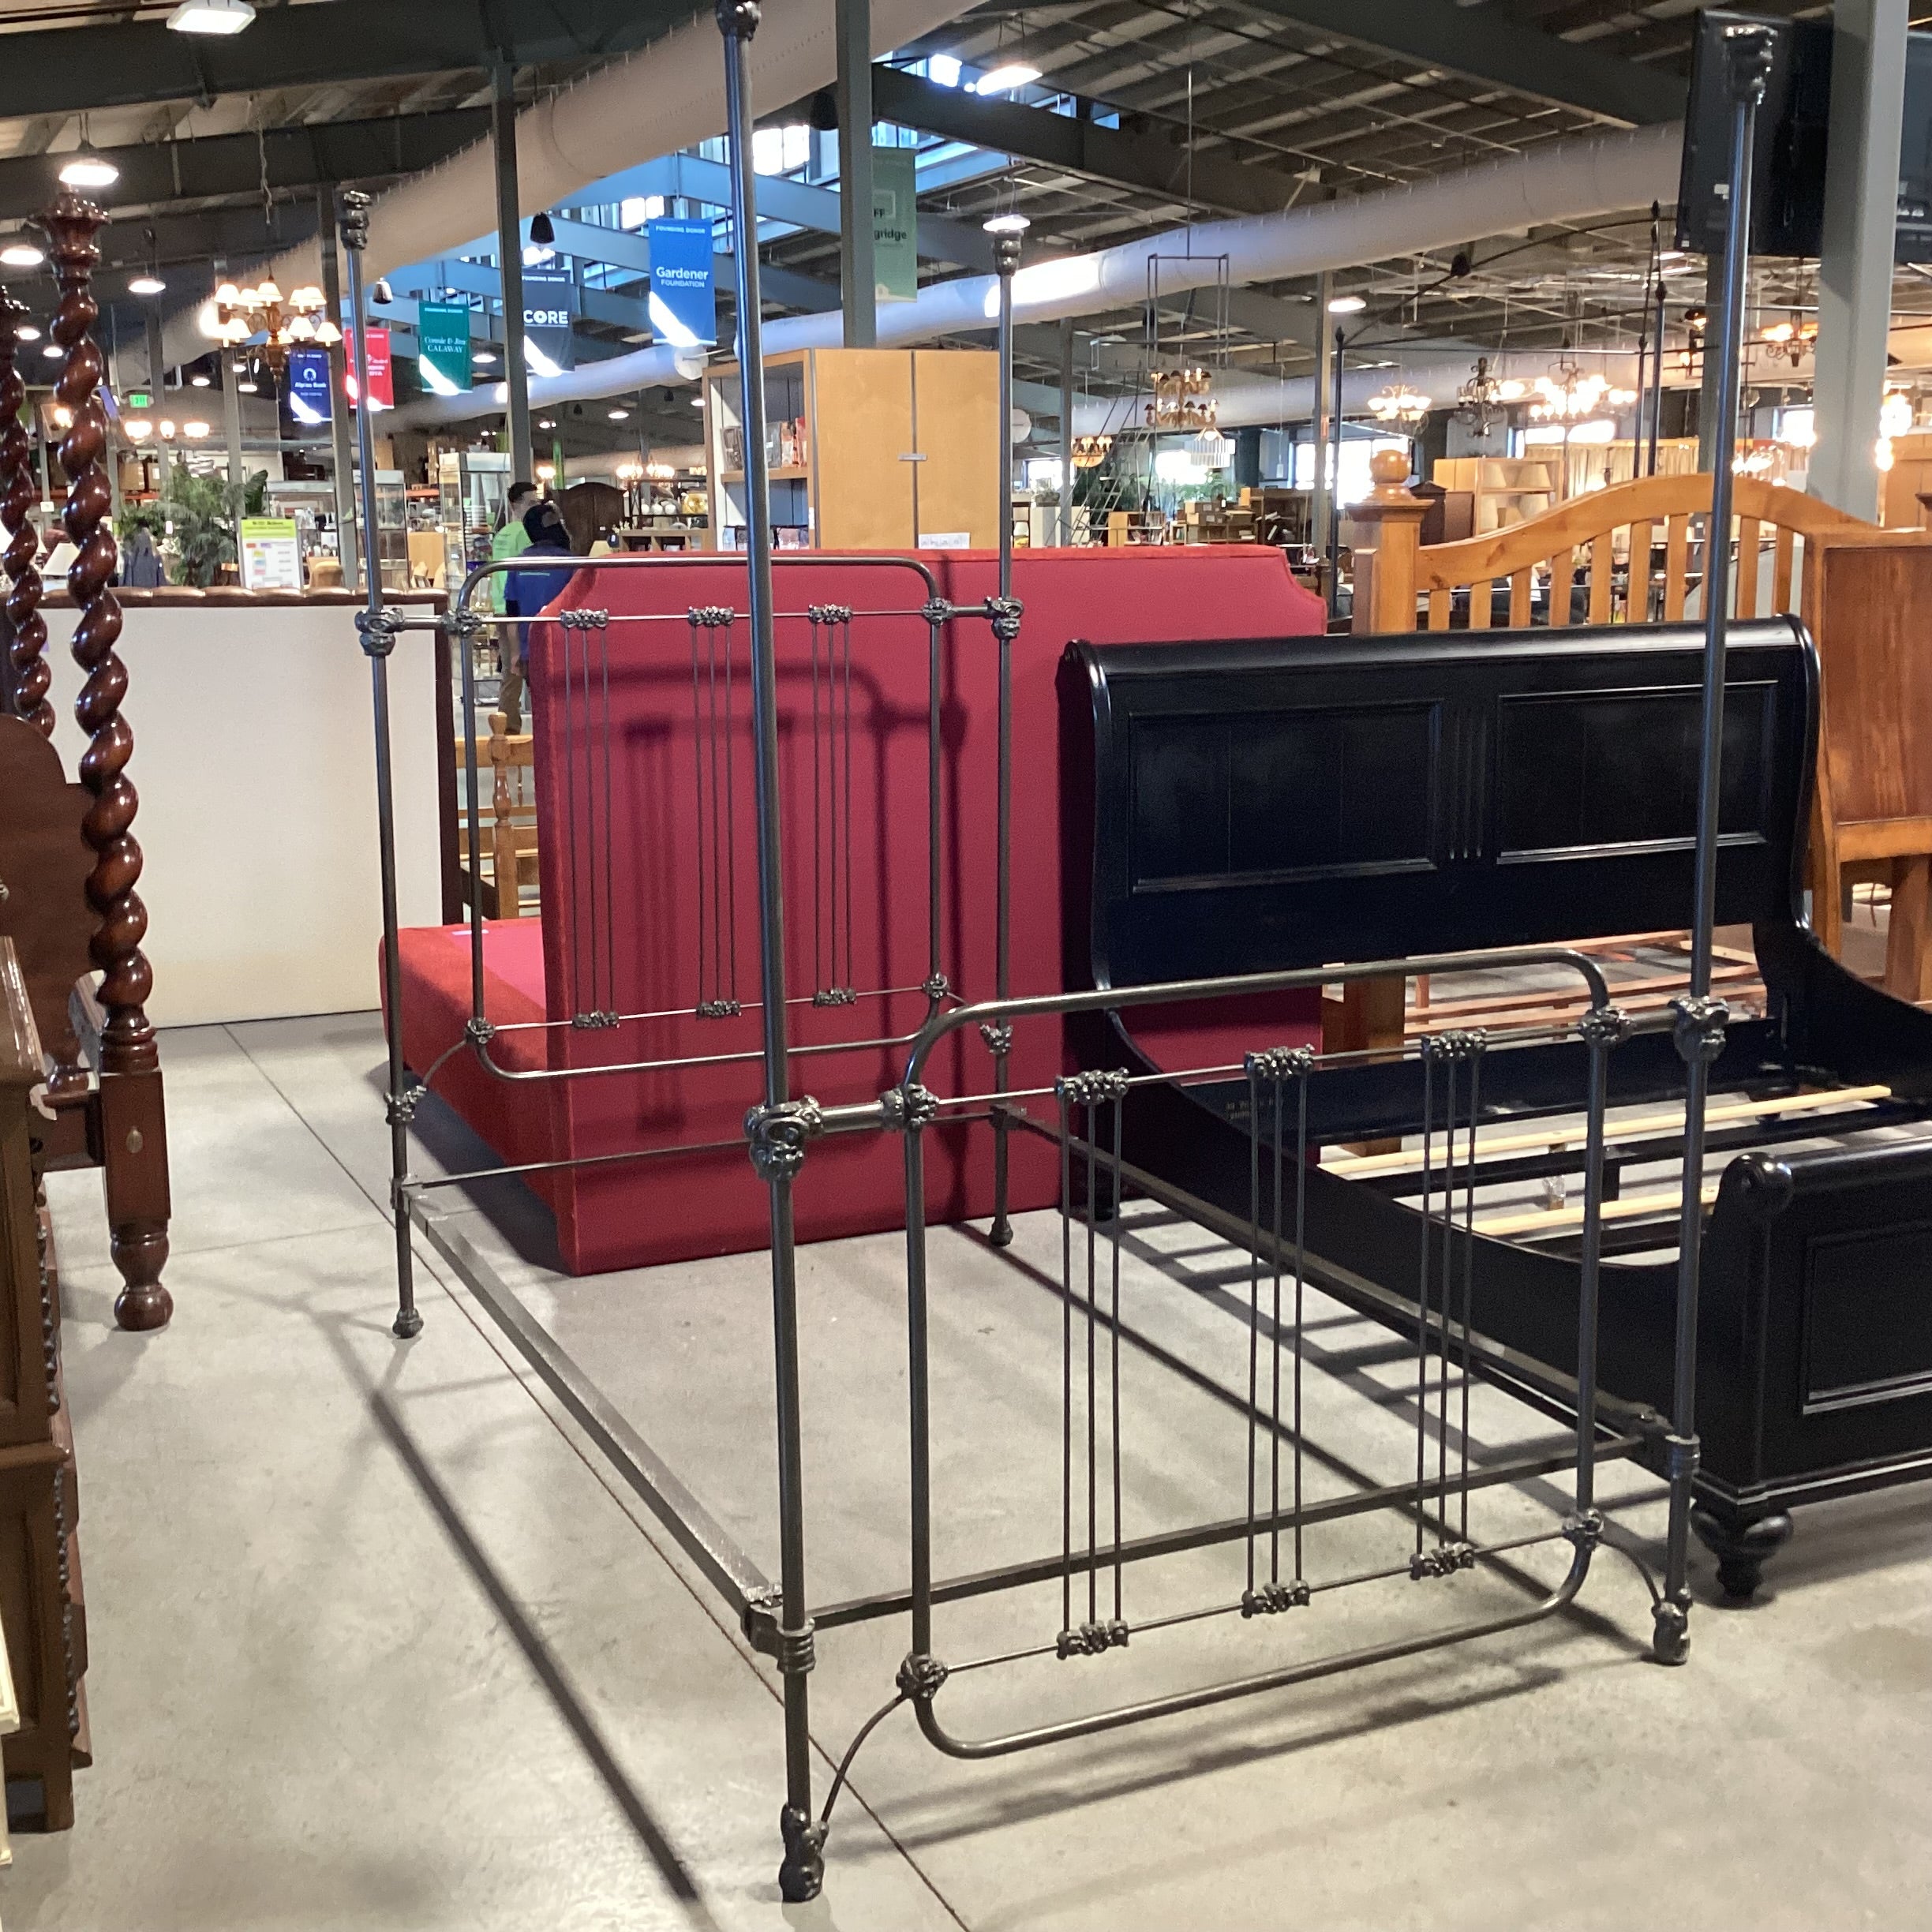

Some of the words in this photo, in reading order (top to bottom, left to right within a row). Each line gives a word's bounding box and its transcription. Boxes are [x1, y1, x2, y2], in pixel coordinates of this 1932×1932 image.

[685, 226, 706, 234] DONOR
[656, 266, 709, 280] Gardener
[661, 279, 706, 288] FOUNDATION
[523, 309, 568, 324] CORE
[427, 344, 463, 354] CALAWAY
